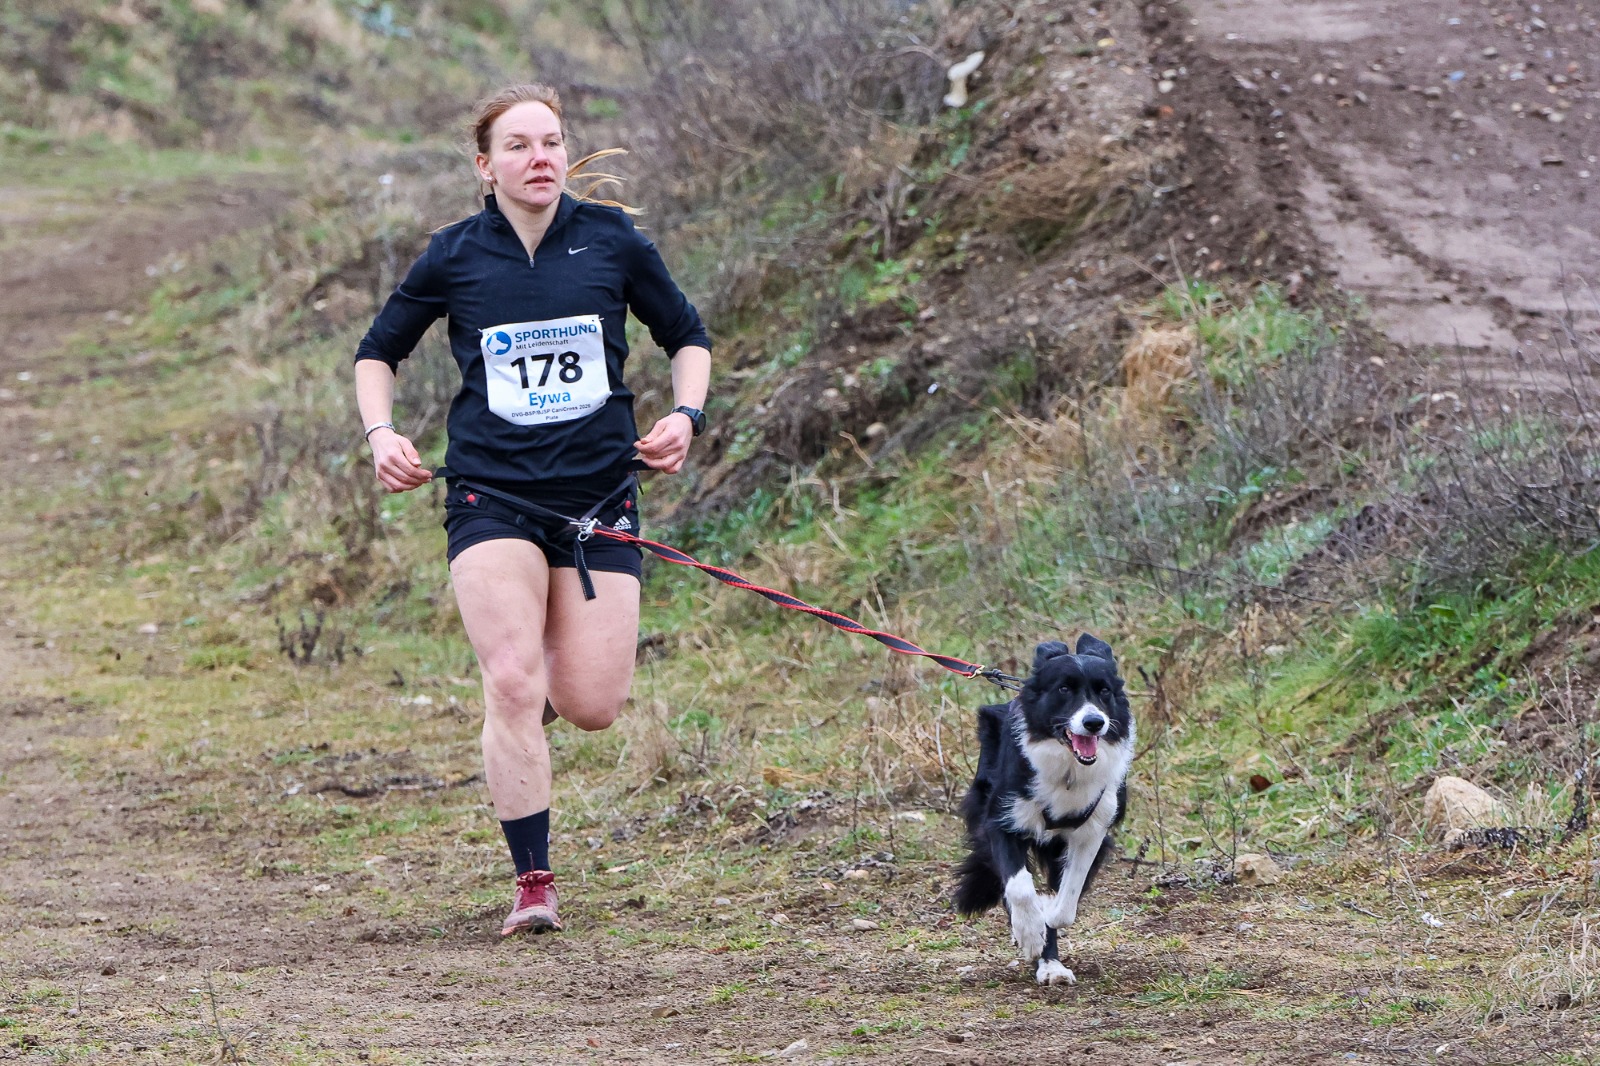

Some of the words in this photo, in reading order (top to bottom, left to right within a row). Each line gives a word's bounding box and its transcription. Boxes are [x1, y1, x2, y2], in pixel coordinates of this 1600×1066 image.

[515, 324, 597, 343] SPORTHUND
[516, 342, 527, 350] Mit
[528, 339, 569, 348] Leidenschaft
[510, 351, 583, 389] 178
[529, 391, 571, 409] Eywa
